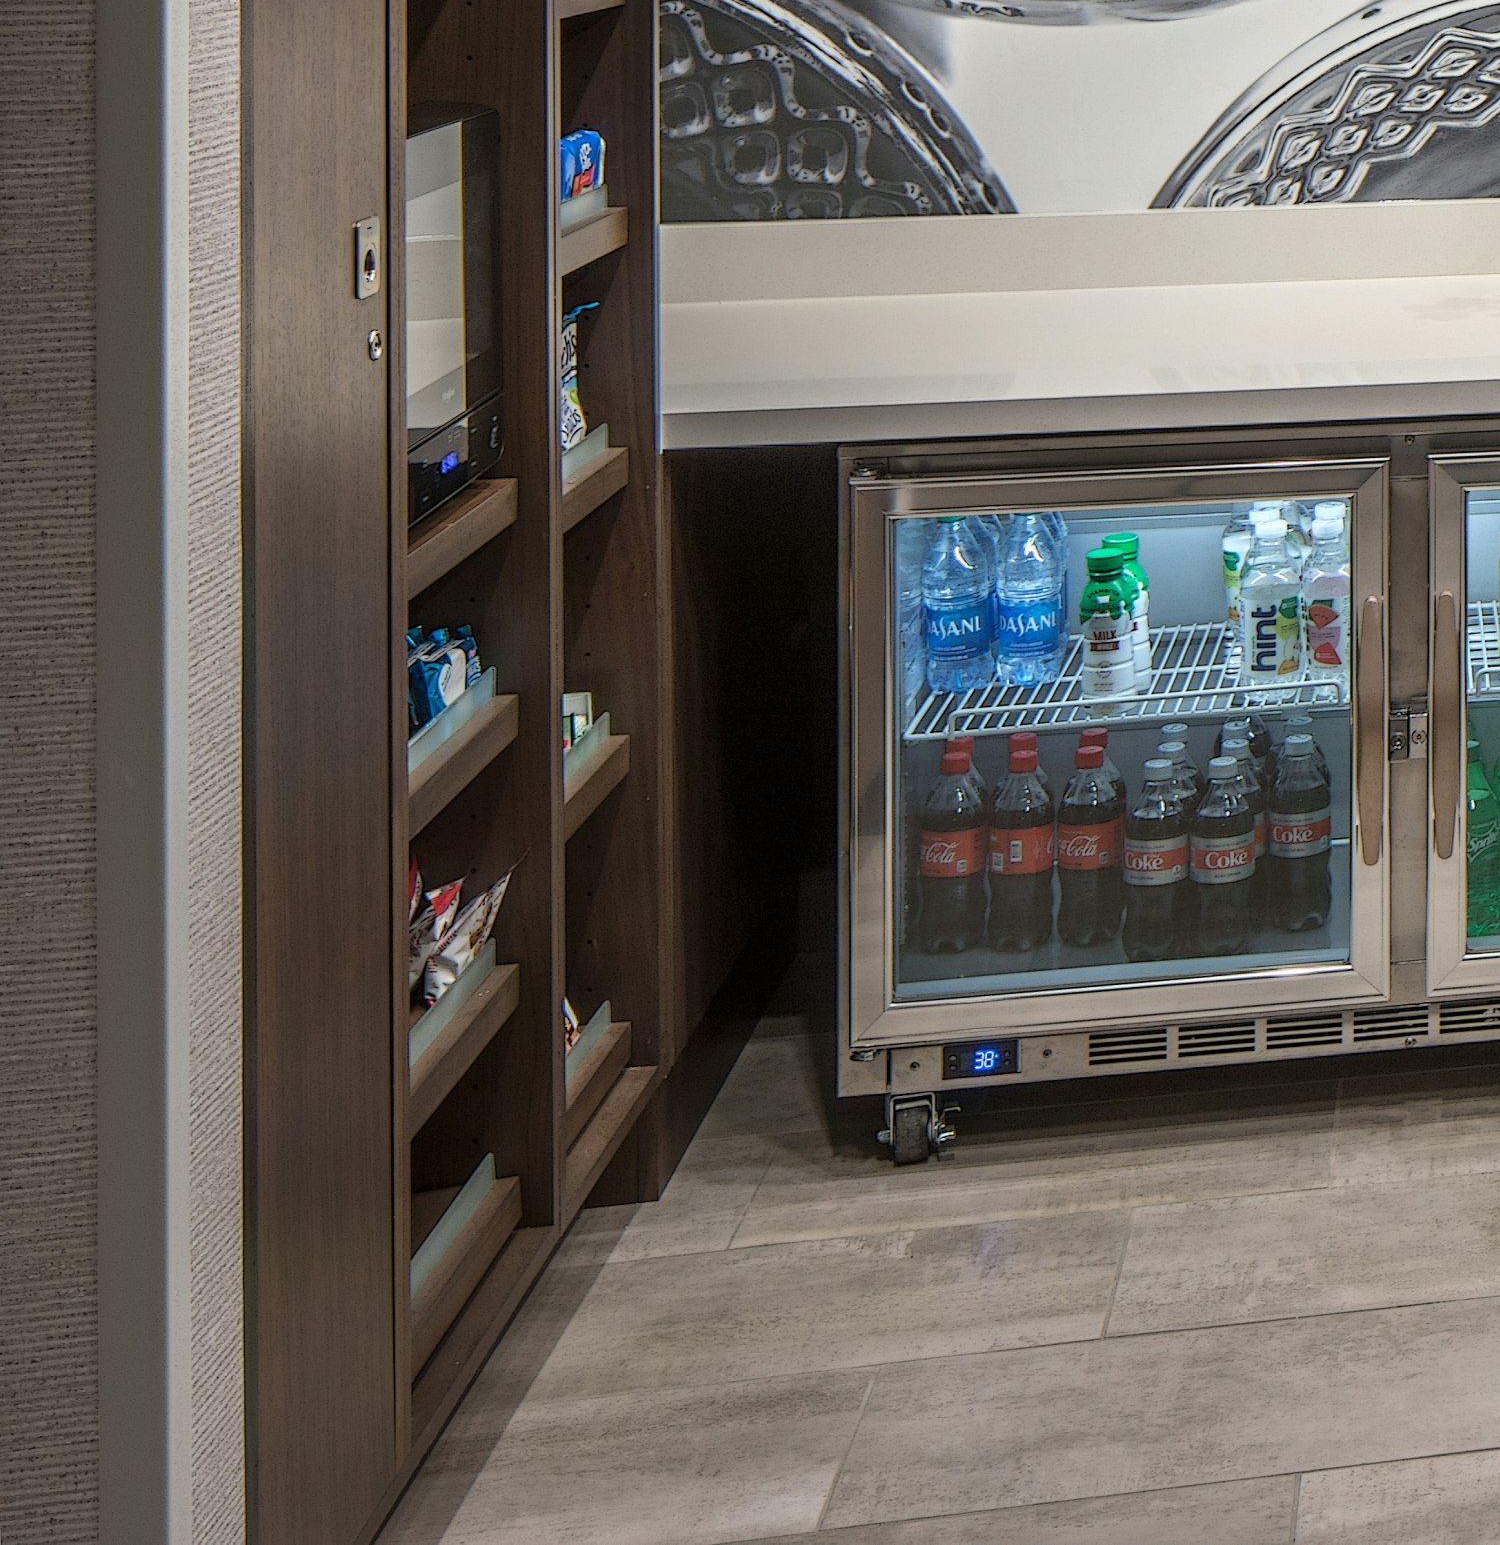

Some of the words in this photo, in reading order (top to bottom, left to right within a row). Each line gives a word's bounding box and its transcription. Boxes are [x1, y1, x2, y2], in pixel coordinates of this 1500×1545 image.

[1000, 611, 1057, 637] DASANI
[1251, 605, 1277, 672] hint
[1273, 826, 1313, 845] Coke
[1125, 851, 1163, 871] Coke
[1205, 851, 1248, 870] Coke
[974, 1050, 995, 1071] 38
